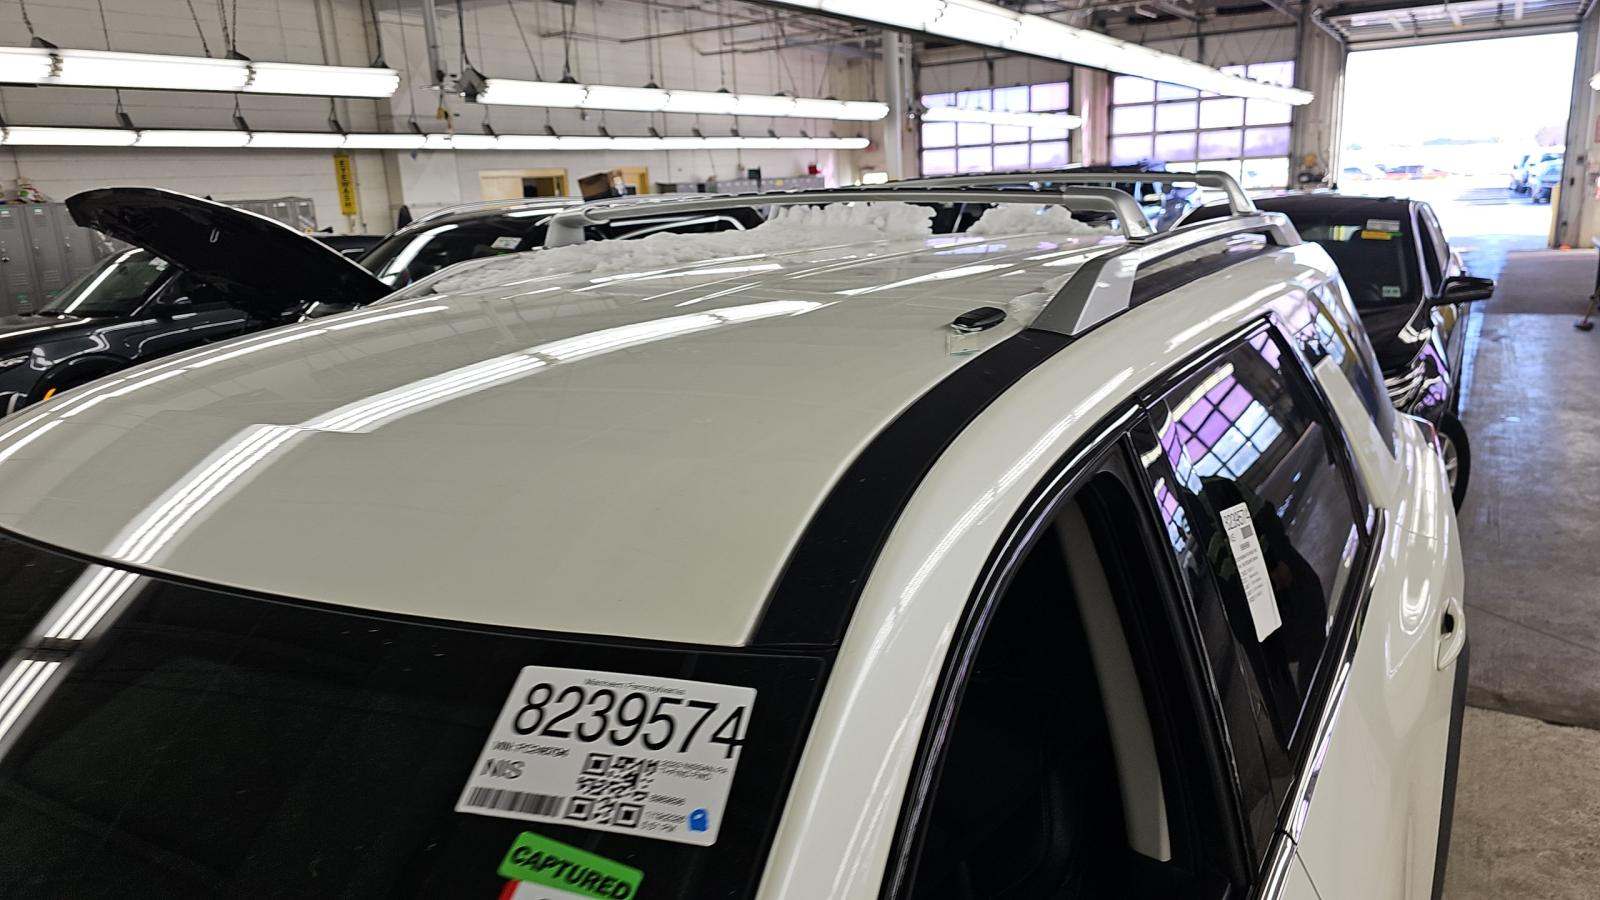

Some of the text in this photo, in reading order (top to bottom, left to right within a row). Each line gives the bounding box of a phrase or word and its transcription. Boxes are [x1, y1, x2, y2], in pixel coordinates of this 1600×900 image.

[512, 682, 747, 760] 8239574
[479, 758, 525, 780] NIS
[510, 845, 633, 899] CAPTURED
